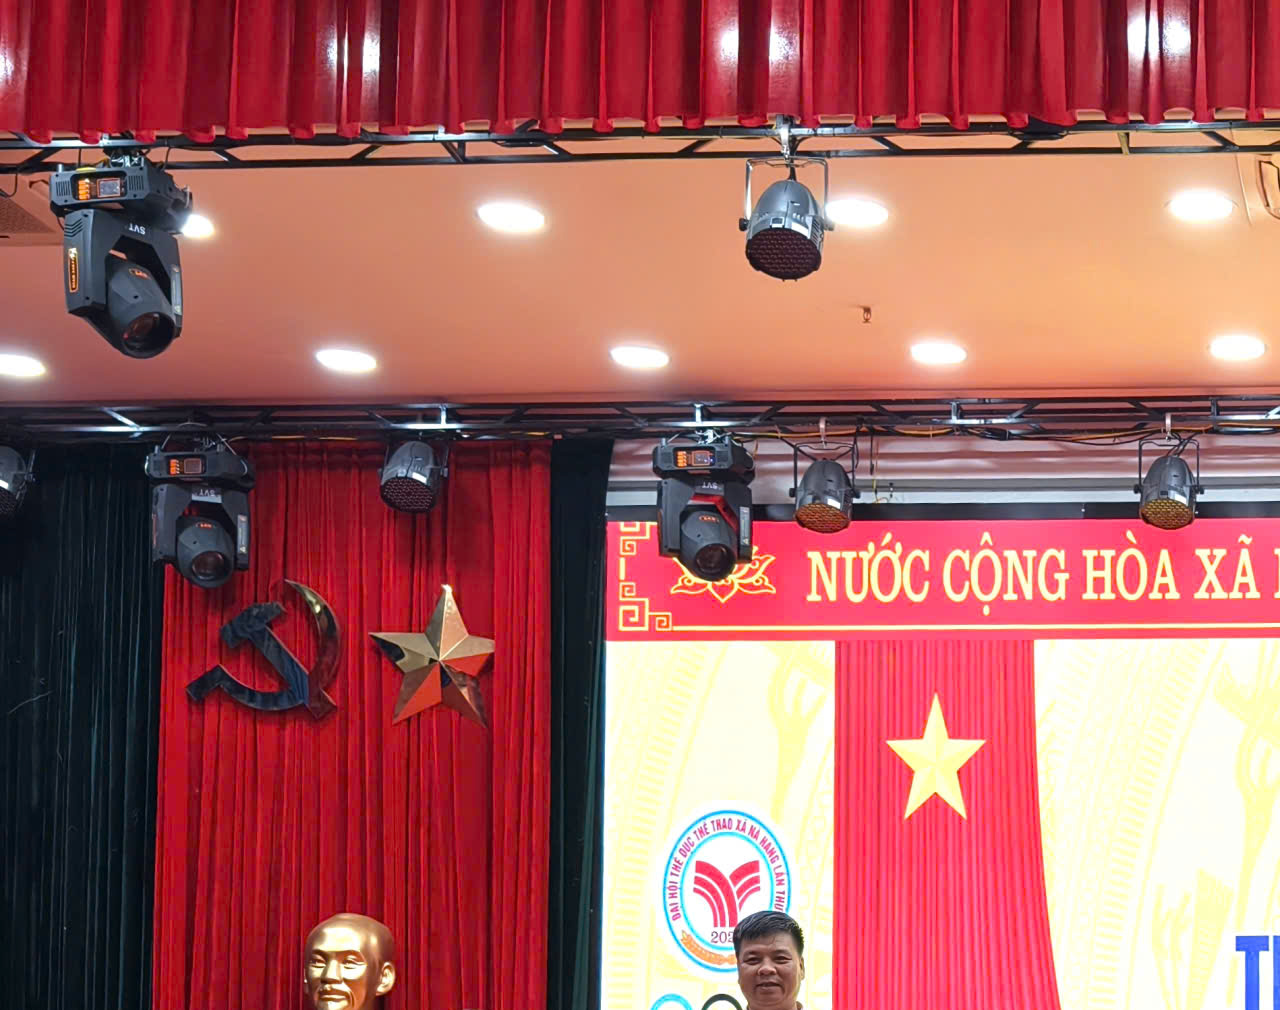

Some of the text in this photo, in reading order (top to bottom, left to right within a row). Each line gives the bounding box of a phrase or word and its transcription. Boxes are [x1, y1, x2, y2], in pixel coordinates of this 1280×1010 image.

[128, 222, 146, 235] SVT
[807, 532, 929, 603] NƯỚC
[943, 532, 1069, 616] CỘNG
[1082, 530, 1180, 600] HÒA
[1194, 534, 1260, 599] XÃ
[711, 818, 733, 832] THAO
[759, 836, 779, 864] HANG
[710, 931, 734, 944] 202
